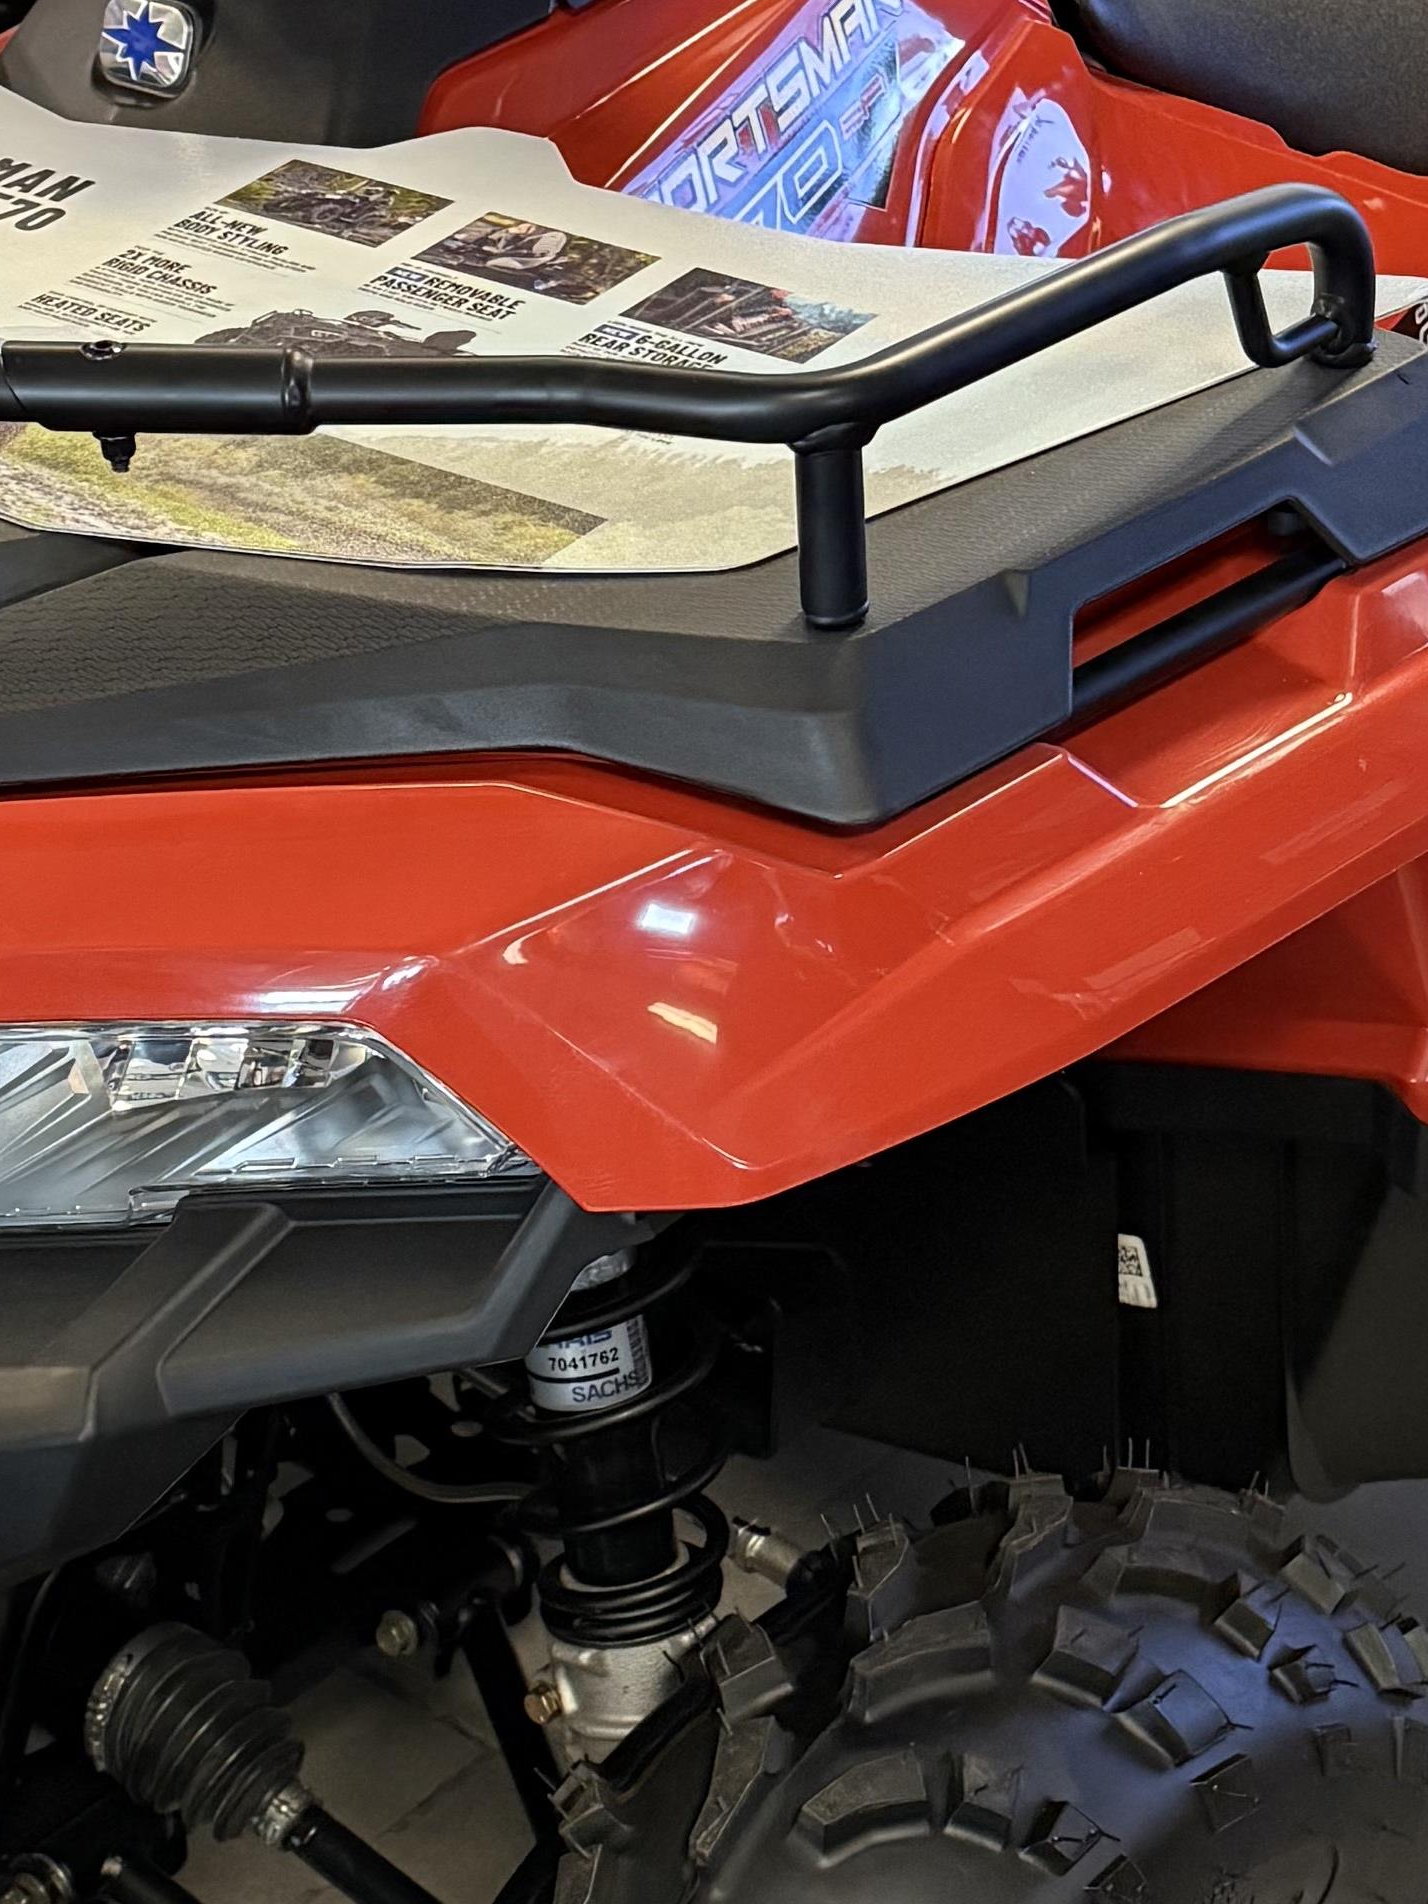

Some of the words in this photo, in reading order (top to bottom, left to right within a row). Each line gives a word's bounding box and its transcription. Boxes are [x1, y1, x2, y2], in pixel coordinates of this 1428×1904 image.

[173, 218, 221, 241] BODY
[217, 230, 289, 256] STYLING
[189, 209, 269, 236] ALL-NEW
[102, 256, 151, 278] RIGID
[150, 268, 217, 295] CHASSIS
[119, 248, 146, 263] 2X
[145, 255, 192, 275] MORE
[370, 274, 470, 309] PASSENGER
[465, 300, 518, 322] SEAT
[424, 274, 527, 310] REMOVABLE
[30, 292, 99, 320] HEATED
[94, 310, 152, 333] SEATS
[577, 332, 630, 355] REAR
[635, 332, 729, 364] 6-GALLON
[548, 1347, 619, 1371] 7041762
[572, 1371, 640, 1403] SACHS
